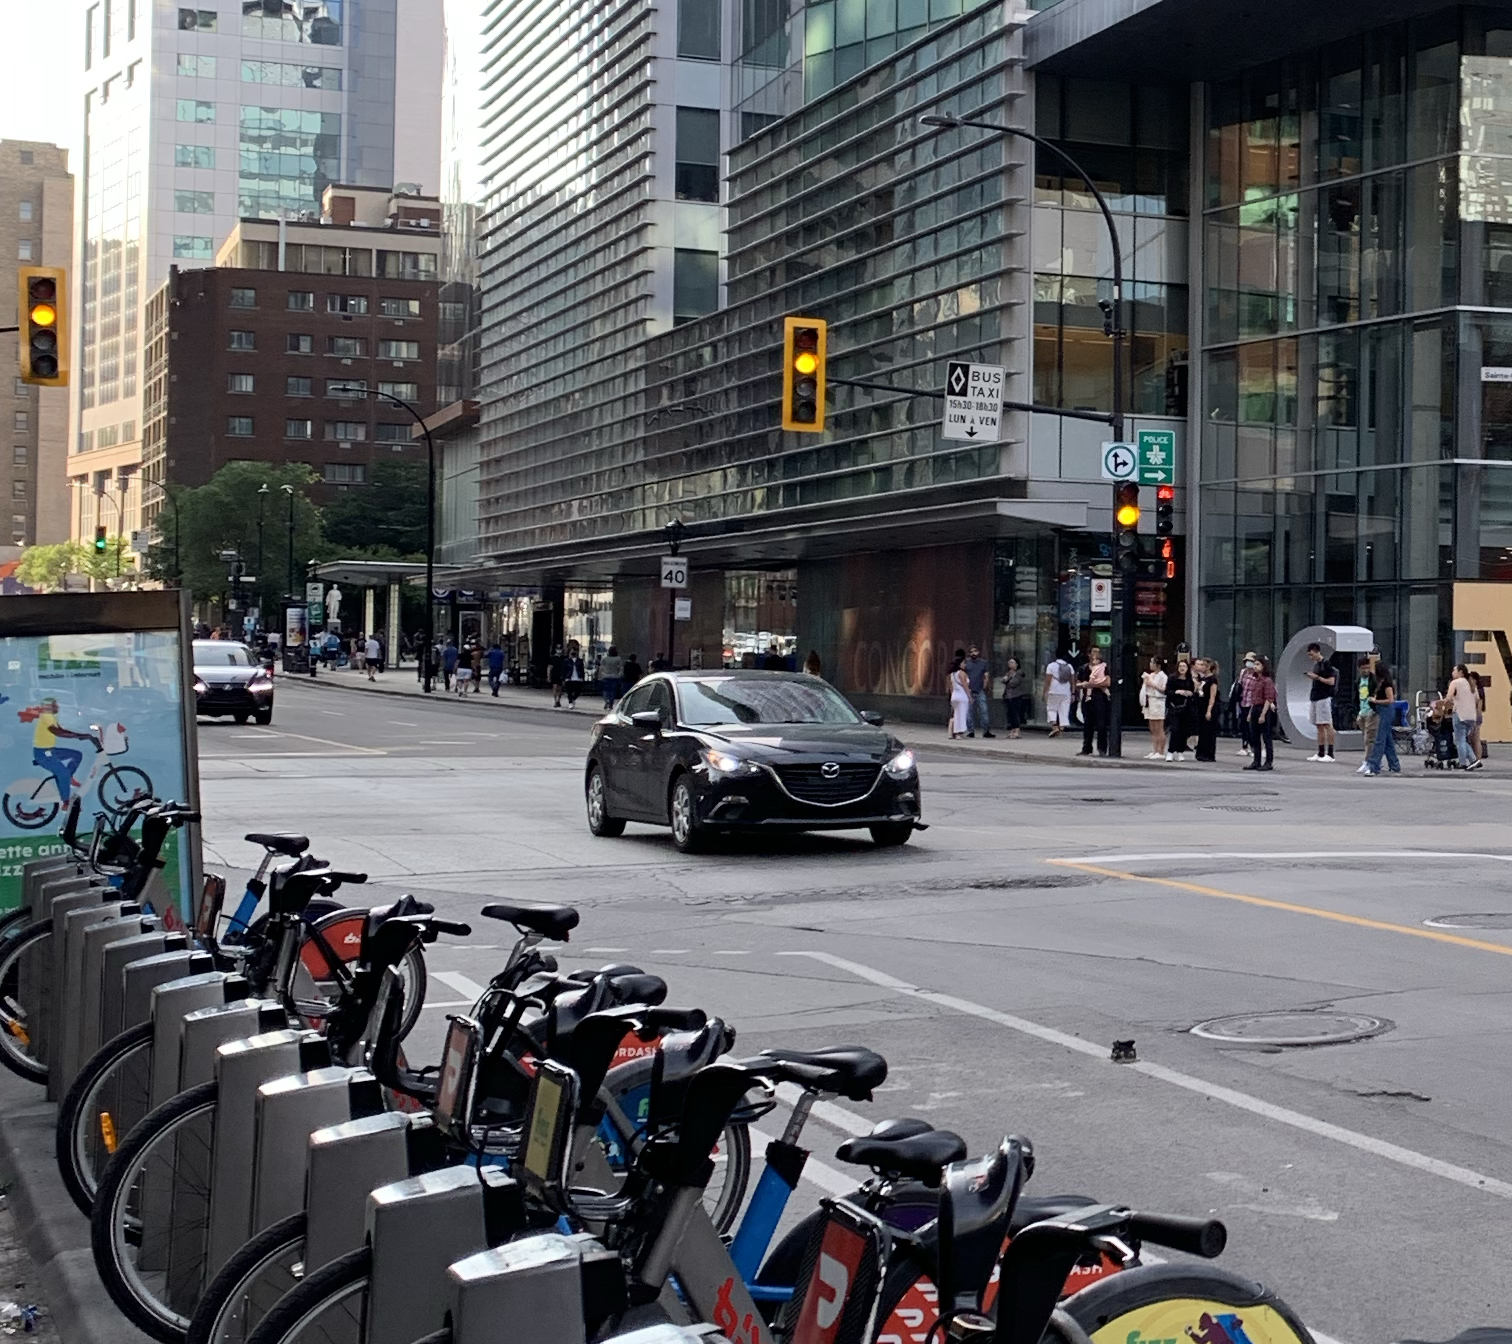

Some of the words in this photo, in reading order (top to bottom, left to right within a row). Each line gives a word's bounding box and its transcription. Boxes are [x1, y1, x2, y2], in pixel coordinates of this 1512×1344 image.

[971, 371, 1001, 384] BUS
[970, 386, 999, 399] TAXI
[949, 414, 966, 424] LUN
[979, 416, 997, 426] VEN
[1142, 435, 1169, 444] POLICE
[663, 569, 685, 584] 40
